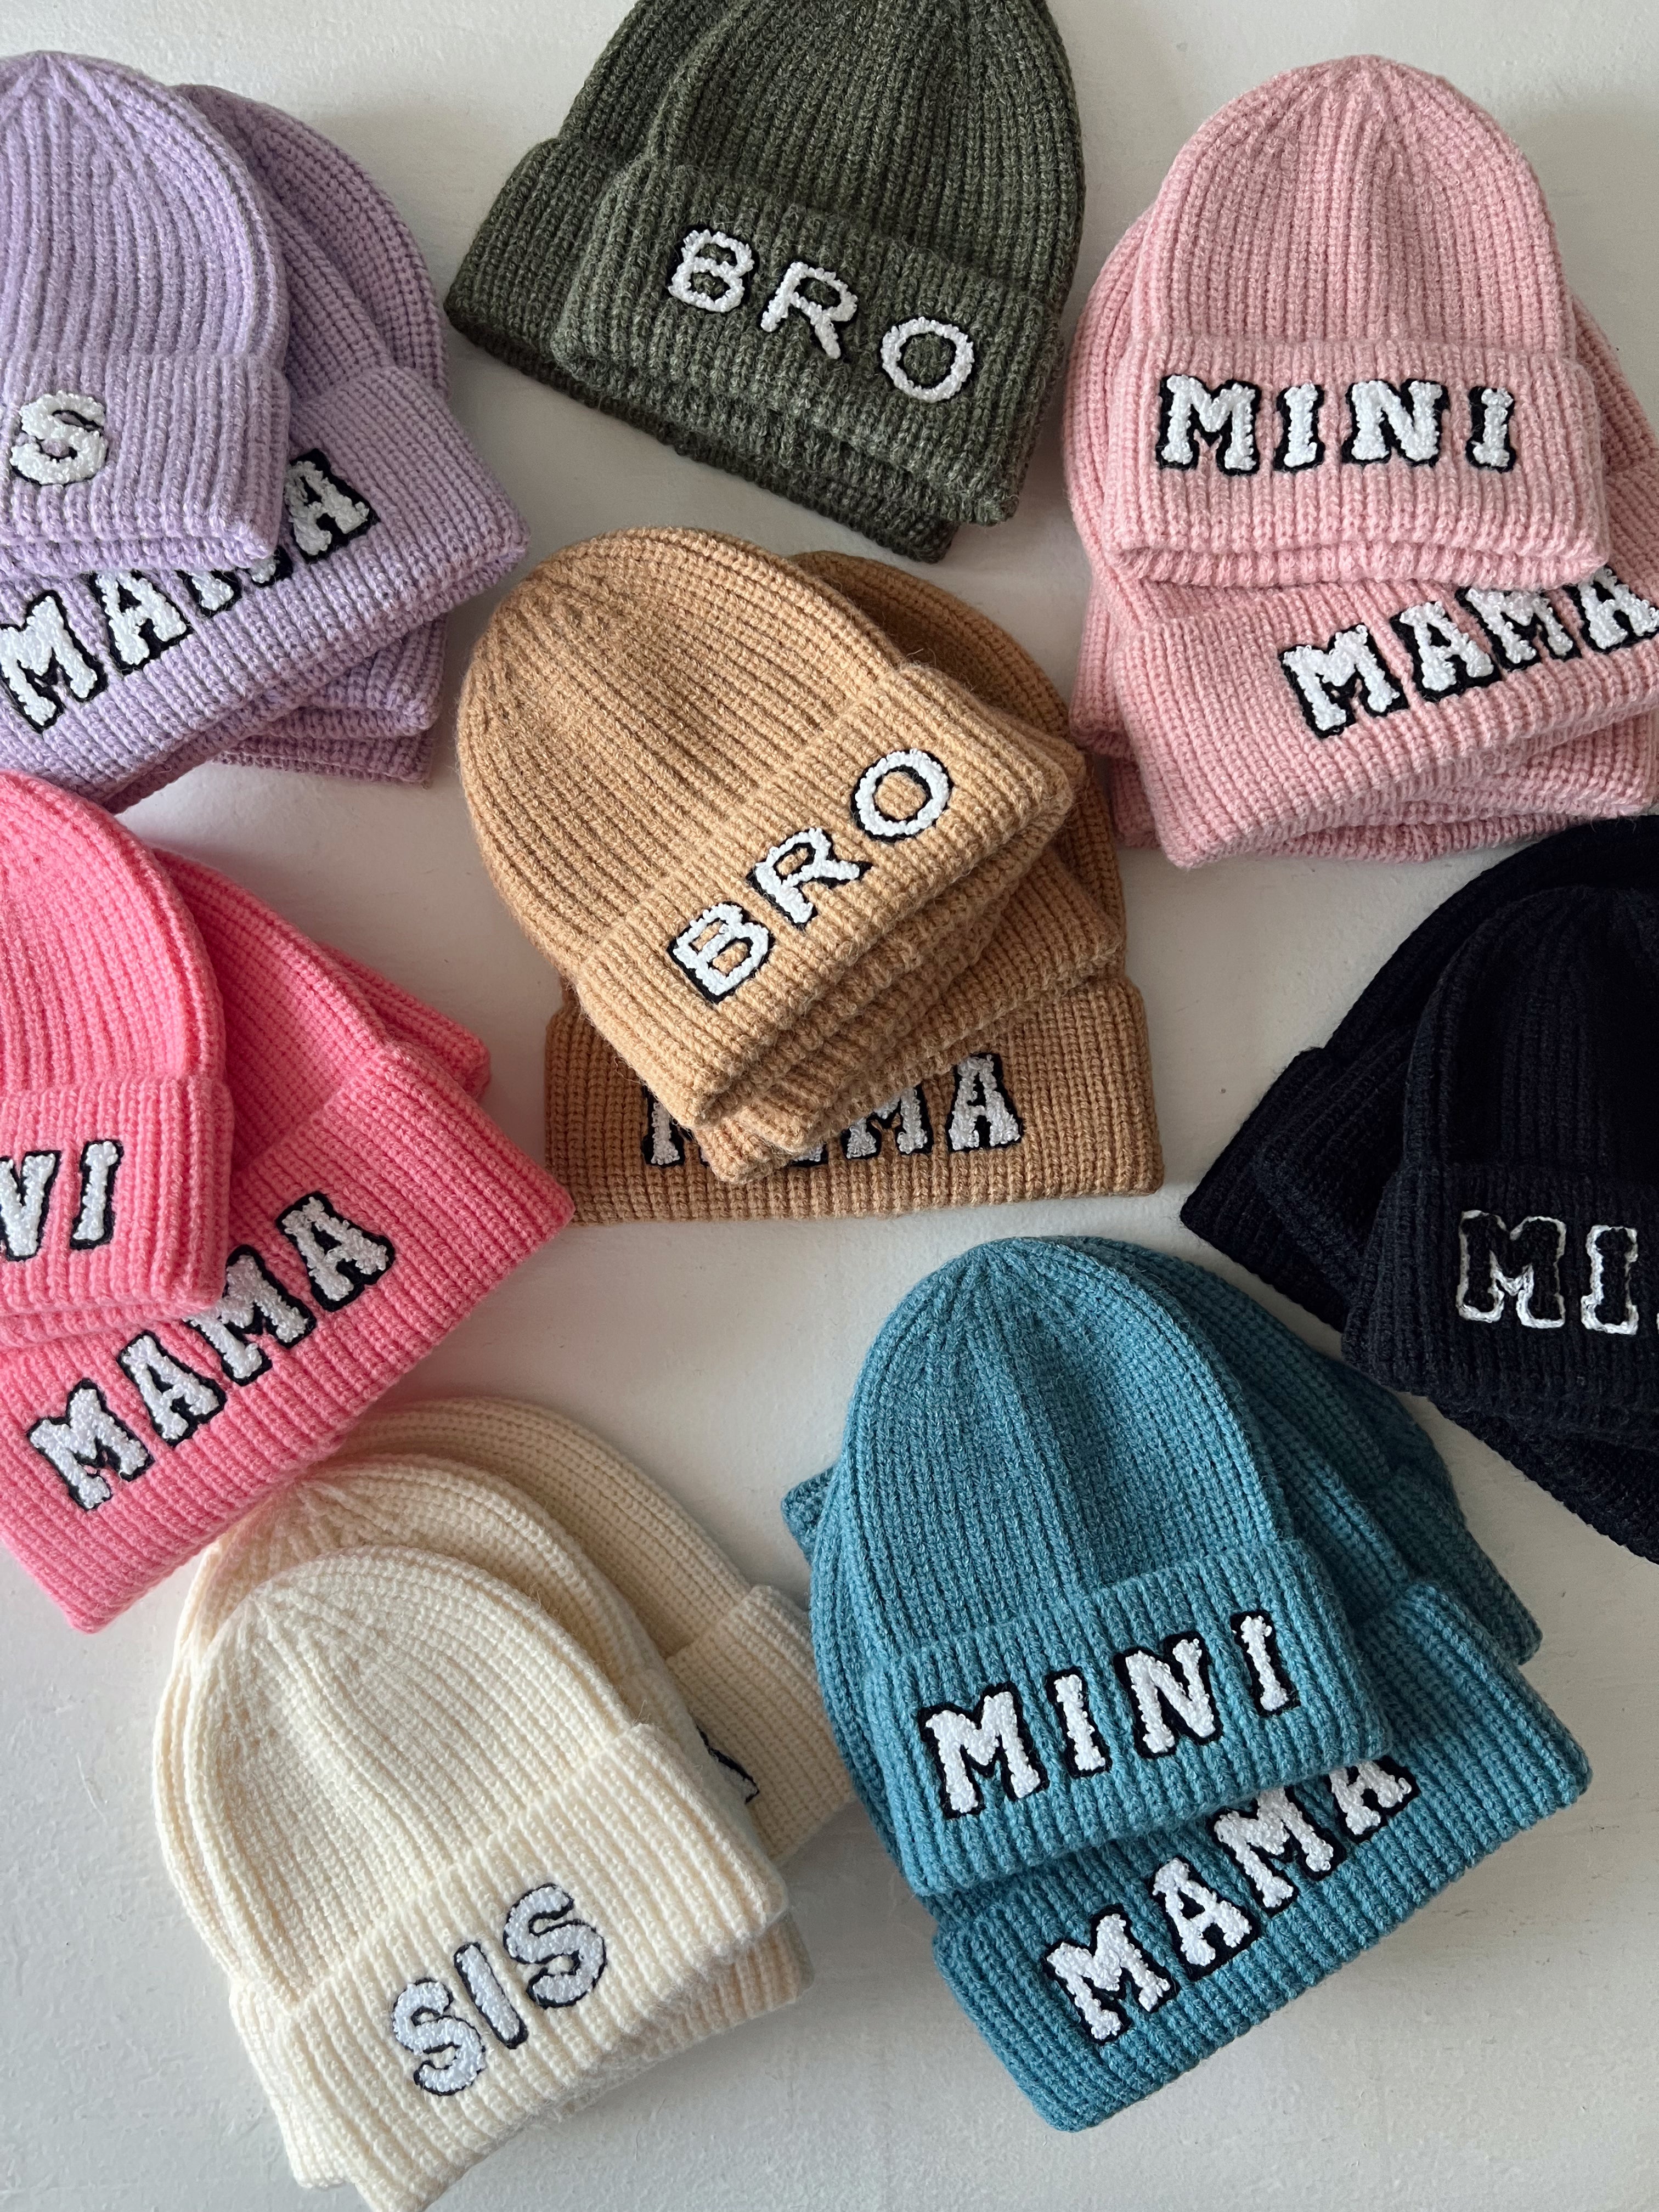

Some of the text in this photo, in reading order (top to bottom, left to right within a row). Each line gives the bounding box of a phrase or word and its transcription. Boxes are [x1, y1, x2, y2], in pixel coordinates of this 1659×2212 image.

[666, 224, 977, 403] BRO
[1156, 374, 1517, 476] MINI
[0, 448, 381, 734] MAA
[1279, 565, 1659, 739] MAMA
[666, 748, 953, 1005] BRO
[27, 1190, 396, 1511] MAMA
[1455, 1210, 1659, 1335] MI
[917, 1610, 1300, 1819] MINI
[392, 1882, 607, 2096] SIS
[1043, 1756, 1422, 2044] MAMA
